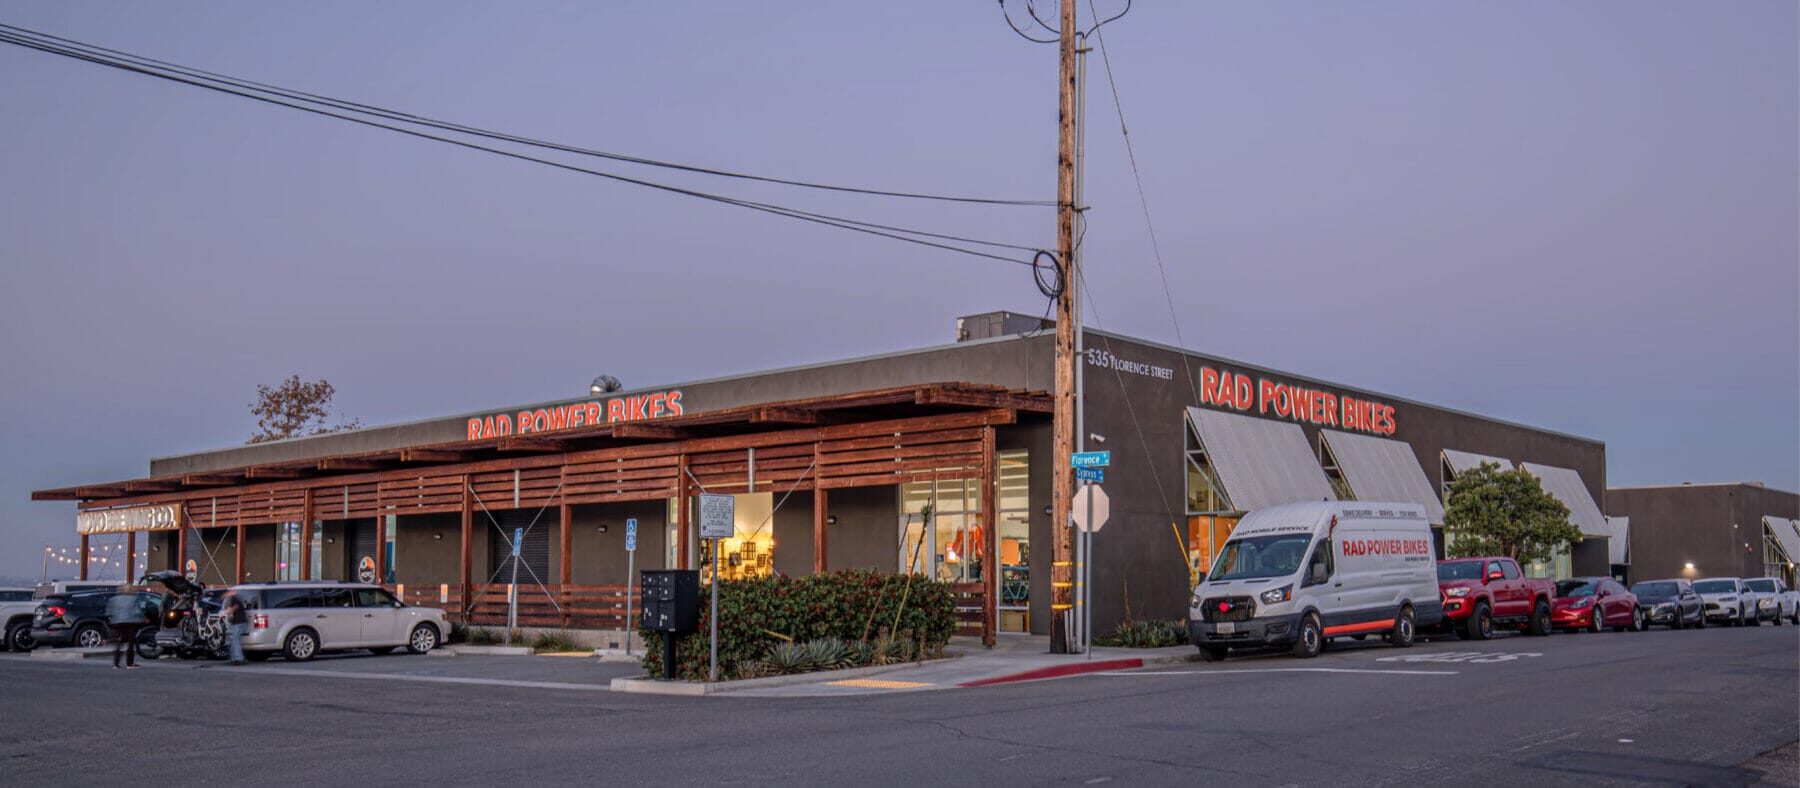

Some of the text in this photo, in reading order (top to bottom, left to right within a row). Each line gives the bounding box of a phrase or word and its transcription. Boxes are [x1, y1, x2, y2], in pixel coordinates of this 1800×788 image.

[1088, 348, 1173, 381] 535 FLORENCE STREET
[467, 390, 684, 441] RAD POWER BIKES
[1201, 366, 1396, 436] RAD POWER BIKES
[1071, 455, 1100, 465] Florence
[1343, 539, 1429, 556] RAD POWER BIKES
